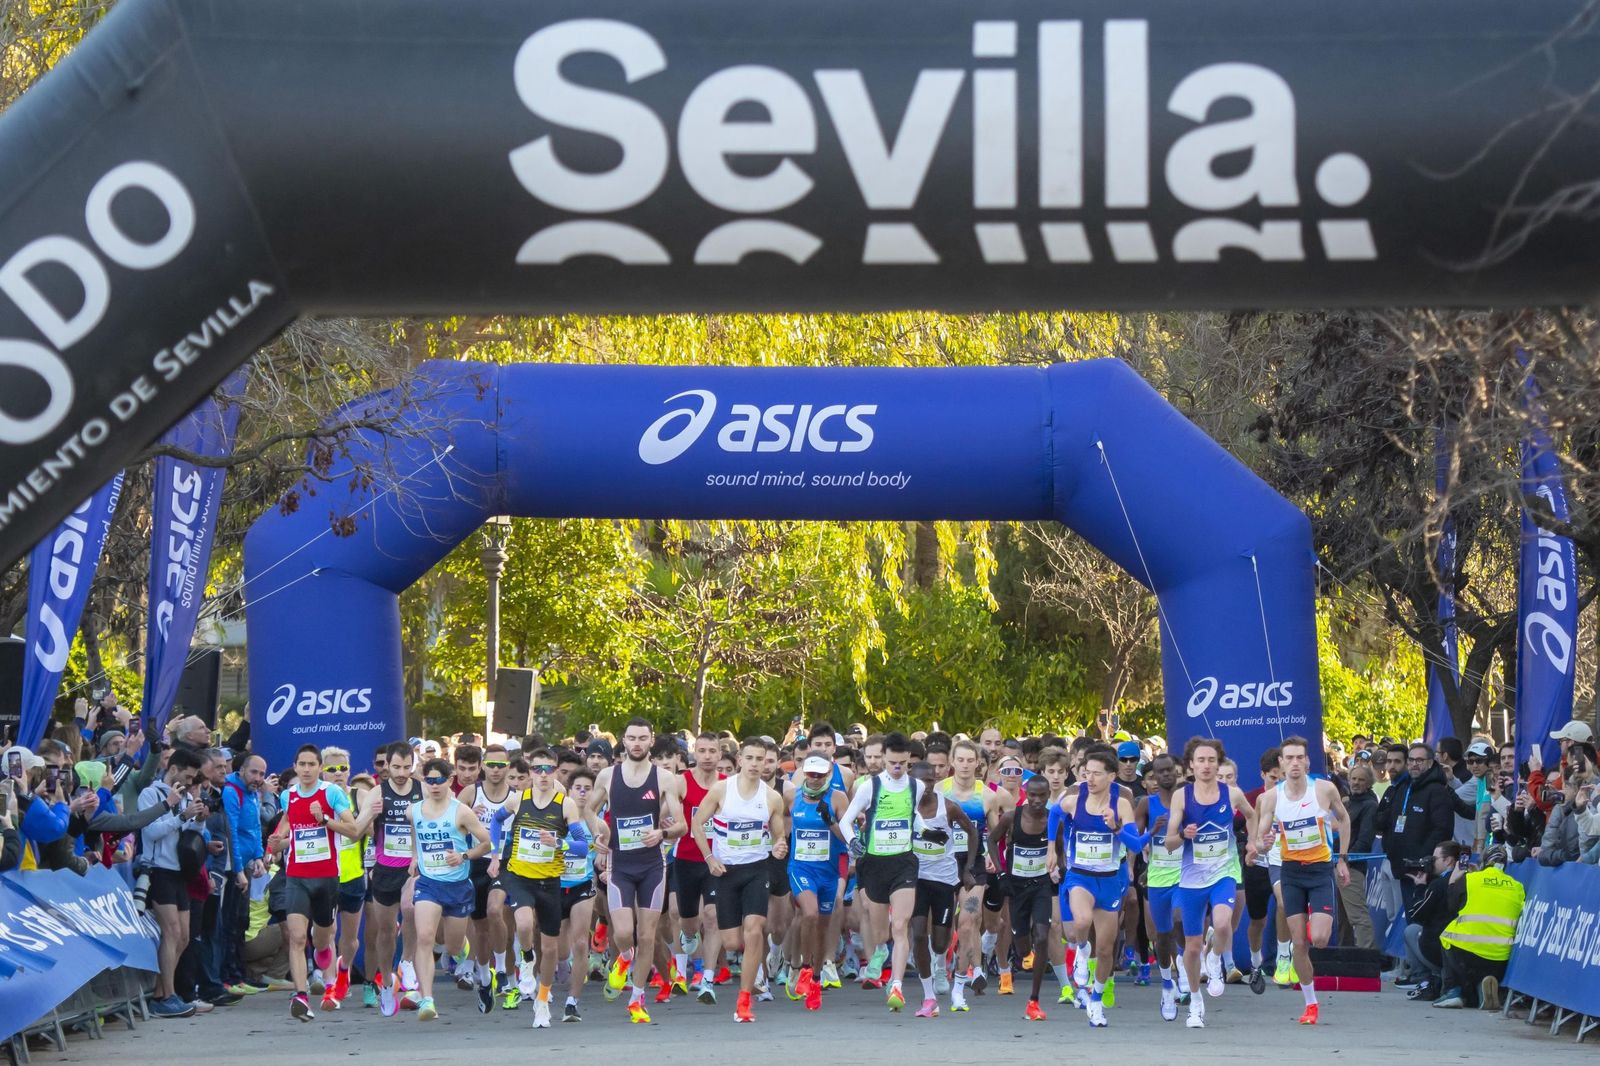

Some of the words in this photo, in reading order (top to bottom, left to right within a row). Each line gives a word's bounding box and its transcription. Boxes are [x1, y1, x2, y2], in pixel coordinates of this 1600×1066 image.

[507, 17, 1372, 213] Sevilla.
[0, 417, 110, 530] MIENTO
[109, 375, 159, 422] DE
[705, 470, 760, 487] sound
[761, 470, 807, 488] mind,
[810, 470, 865, 487] sound
[866, 470, 912, 489] body
[292, 724, 318, 734] sound
[318, 722, 342, 733] mind,
[343, 722, 368, 732] sound
[368, 721, 386, 732] body
[1215, 716, 1241, 728] sound
[1266, 714, 1290, 725] sound
[1290, 714, 1307, 726] body
[418, 830, 451, 841] nerja
